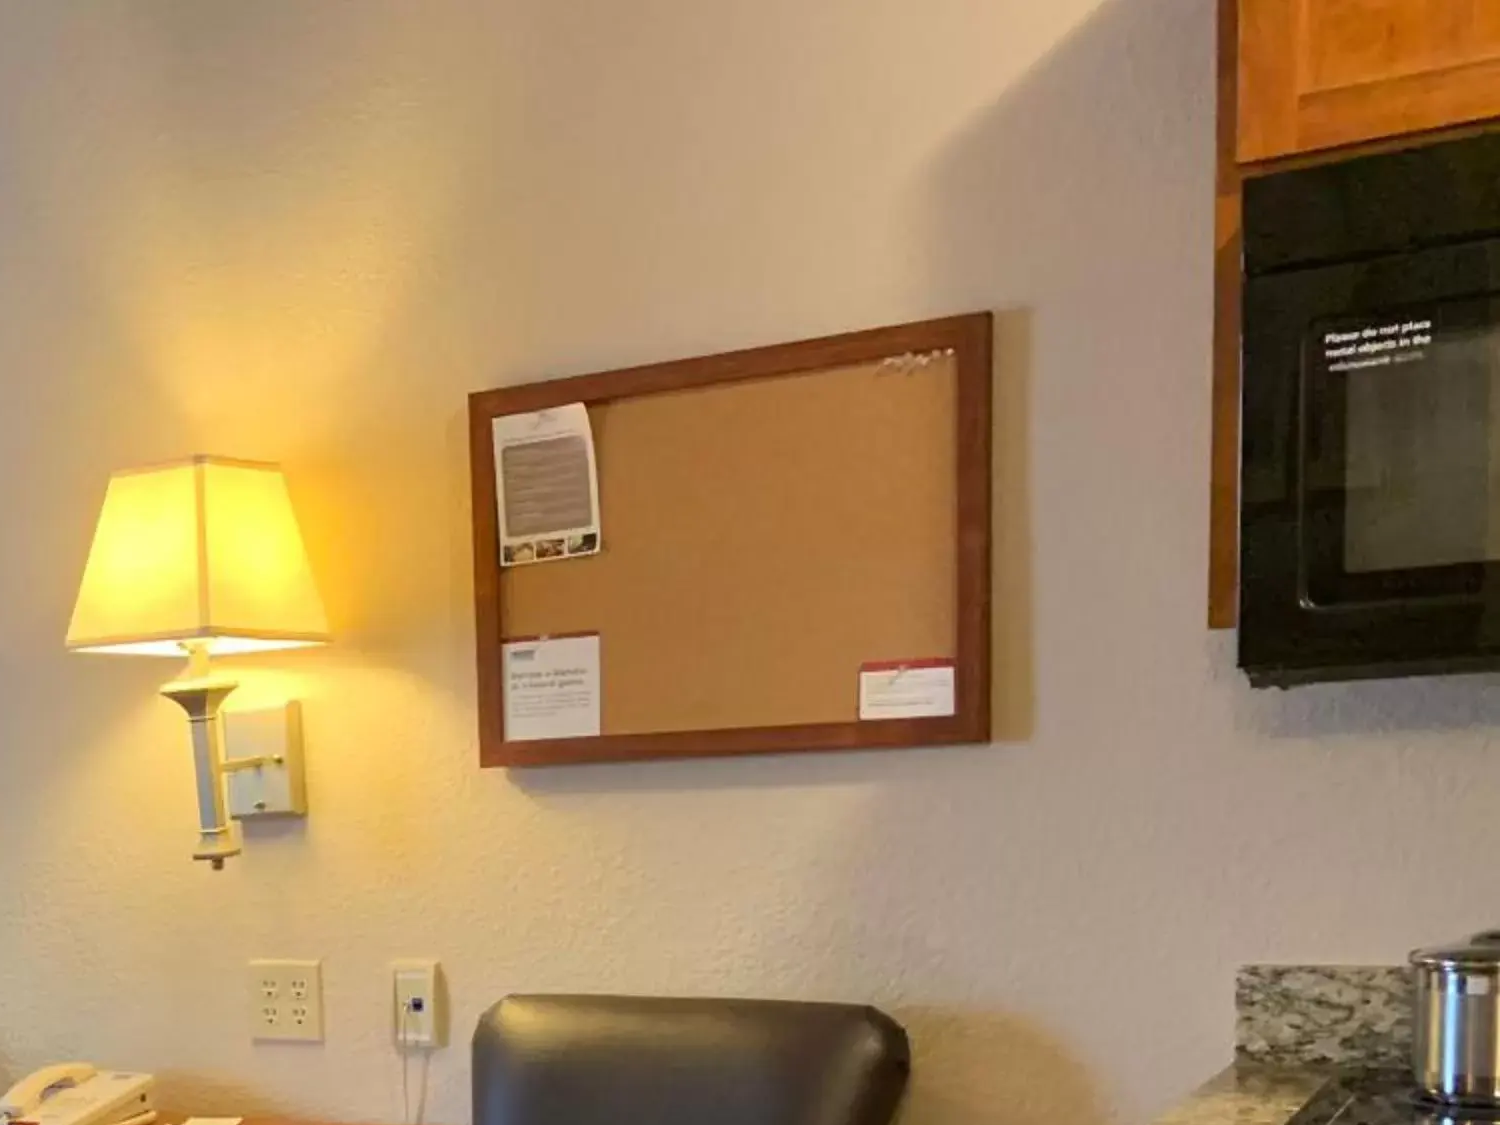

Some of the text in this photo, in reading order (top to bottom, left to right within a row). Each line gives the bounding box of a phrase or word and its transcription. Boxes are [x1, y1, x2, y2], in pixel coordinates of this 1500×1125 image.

[1325, 320, 1431, 343] Please do not place
[1325, 334, 1431, 357] metal objects in the
